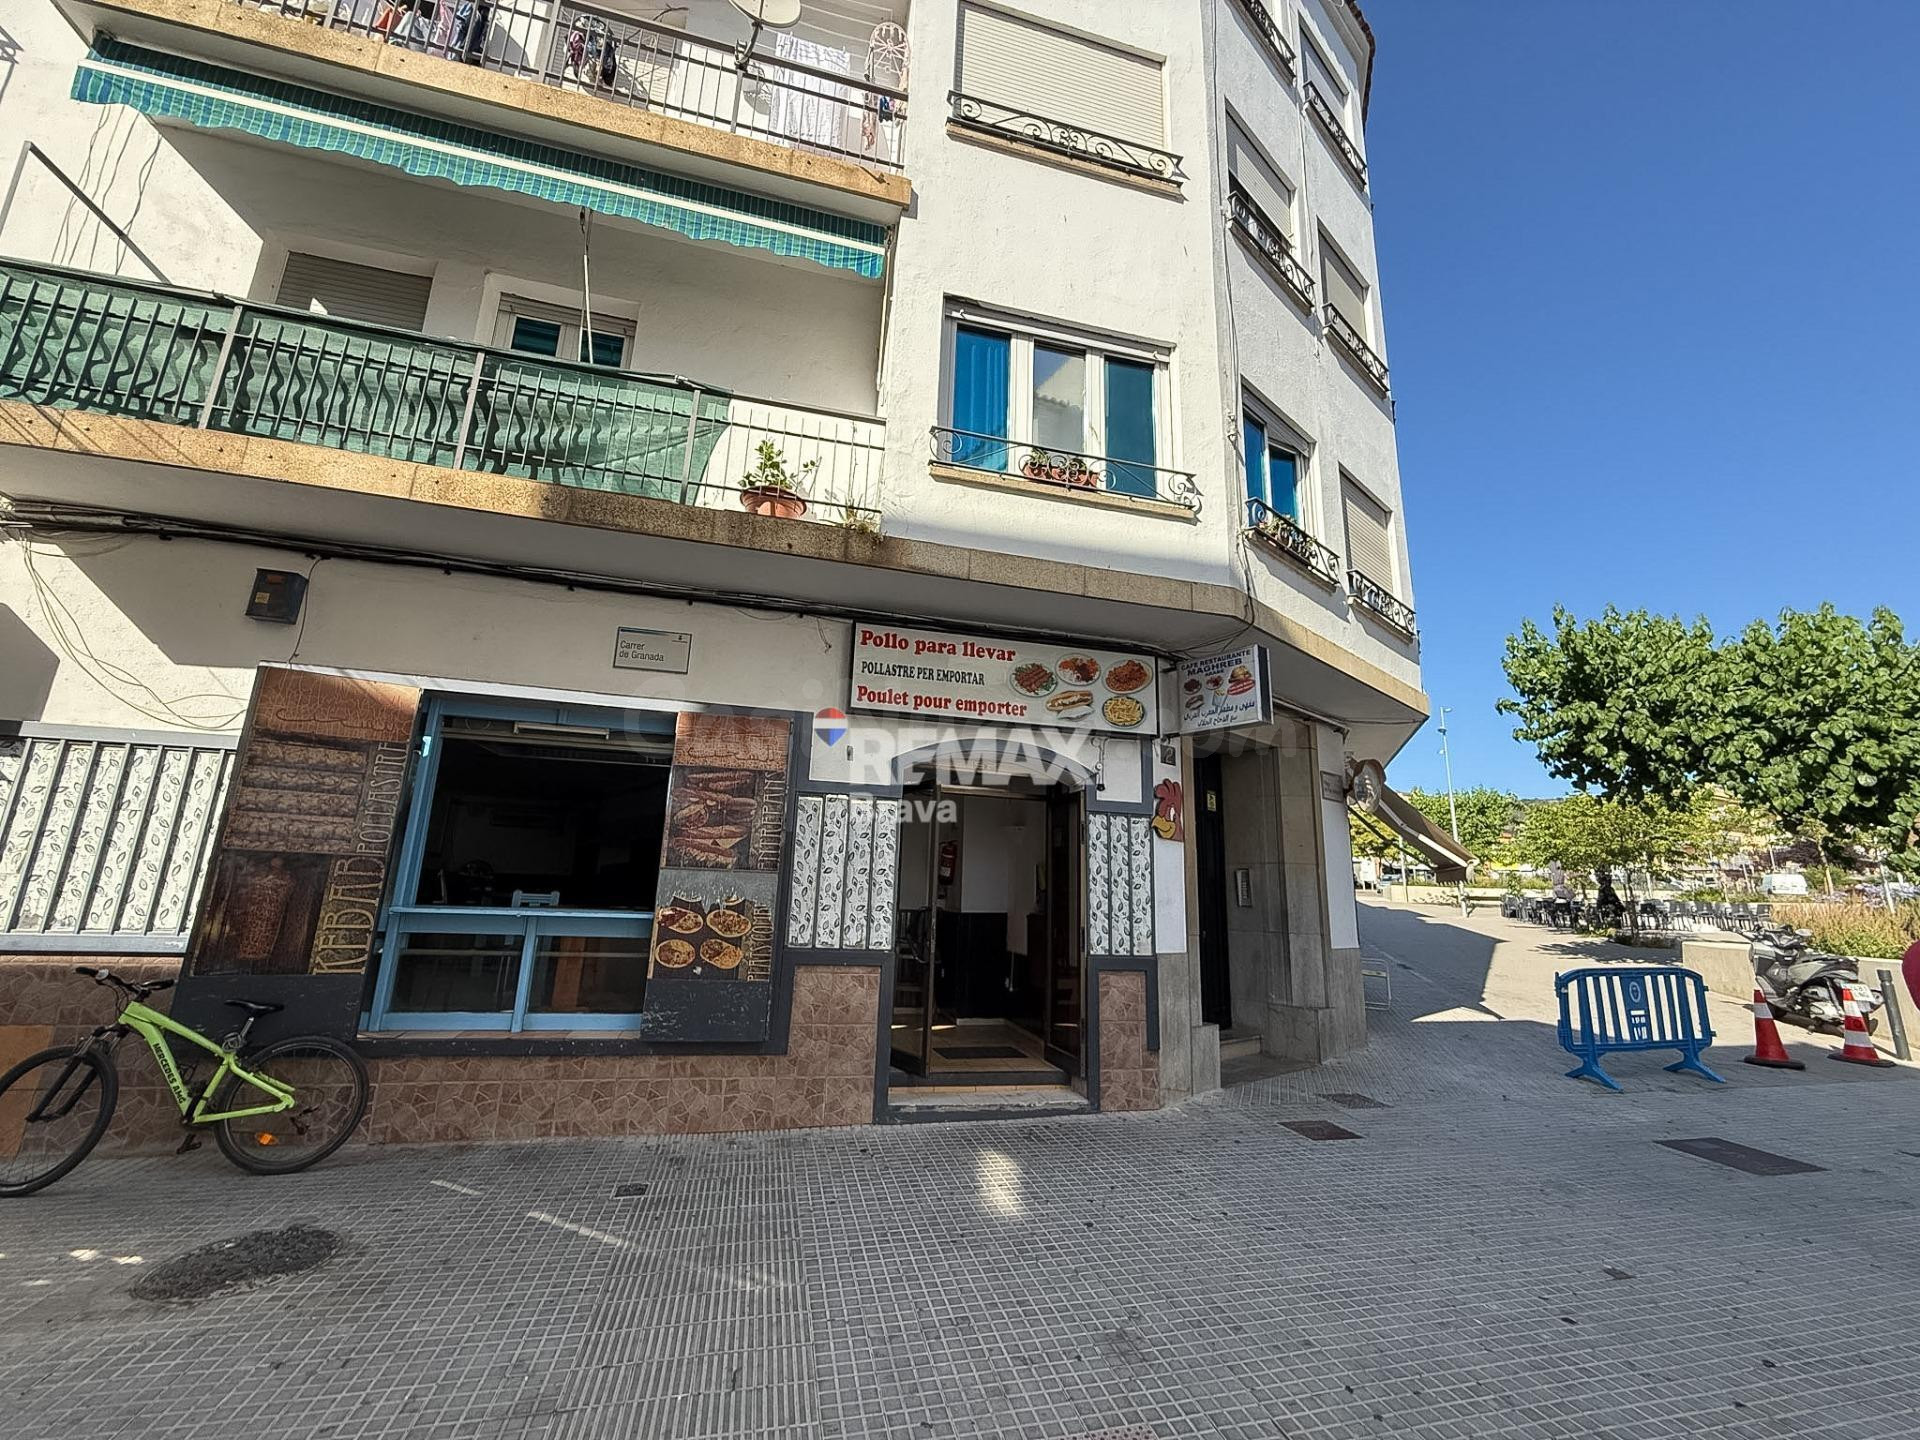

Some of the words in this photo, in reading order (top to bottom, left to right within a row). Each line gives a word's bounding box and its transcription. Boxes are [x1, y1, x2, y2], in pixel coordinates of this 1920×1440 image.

[619, 650, 629, 658] de
[631, 651, 664, 662] Granada
[620, 640, 645, 650] Carrer
[860, 630, 909, 650] Pollo
[914, 639, 957, 655] para
[962, 641, 1016, 662] llevar
[1200, 650, 1251, 666] RESTAURANTE
[861, 661, 916, 678] POLLASTRE
[917, 667, 935, 681] PER
[936, 670, 985, 686] EMPORTAR
[1187, 658, 1242, 676] MAGHREB
[857, 685, 909, 706] Poulet
[913, 695, 952, 711] pour
[955, 700, 1027, 717] emporter
[312, 856, 386, 975] KEBAB
[747, 945, 773, 982] PLATS
[152, 1043, 177, 1084] MERCEDES
[173, 1085, 187, 1104] AMG
